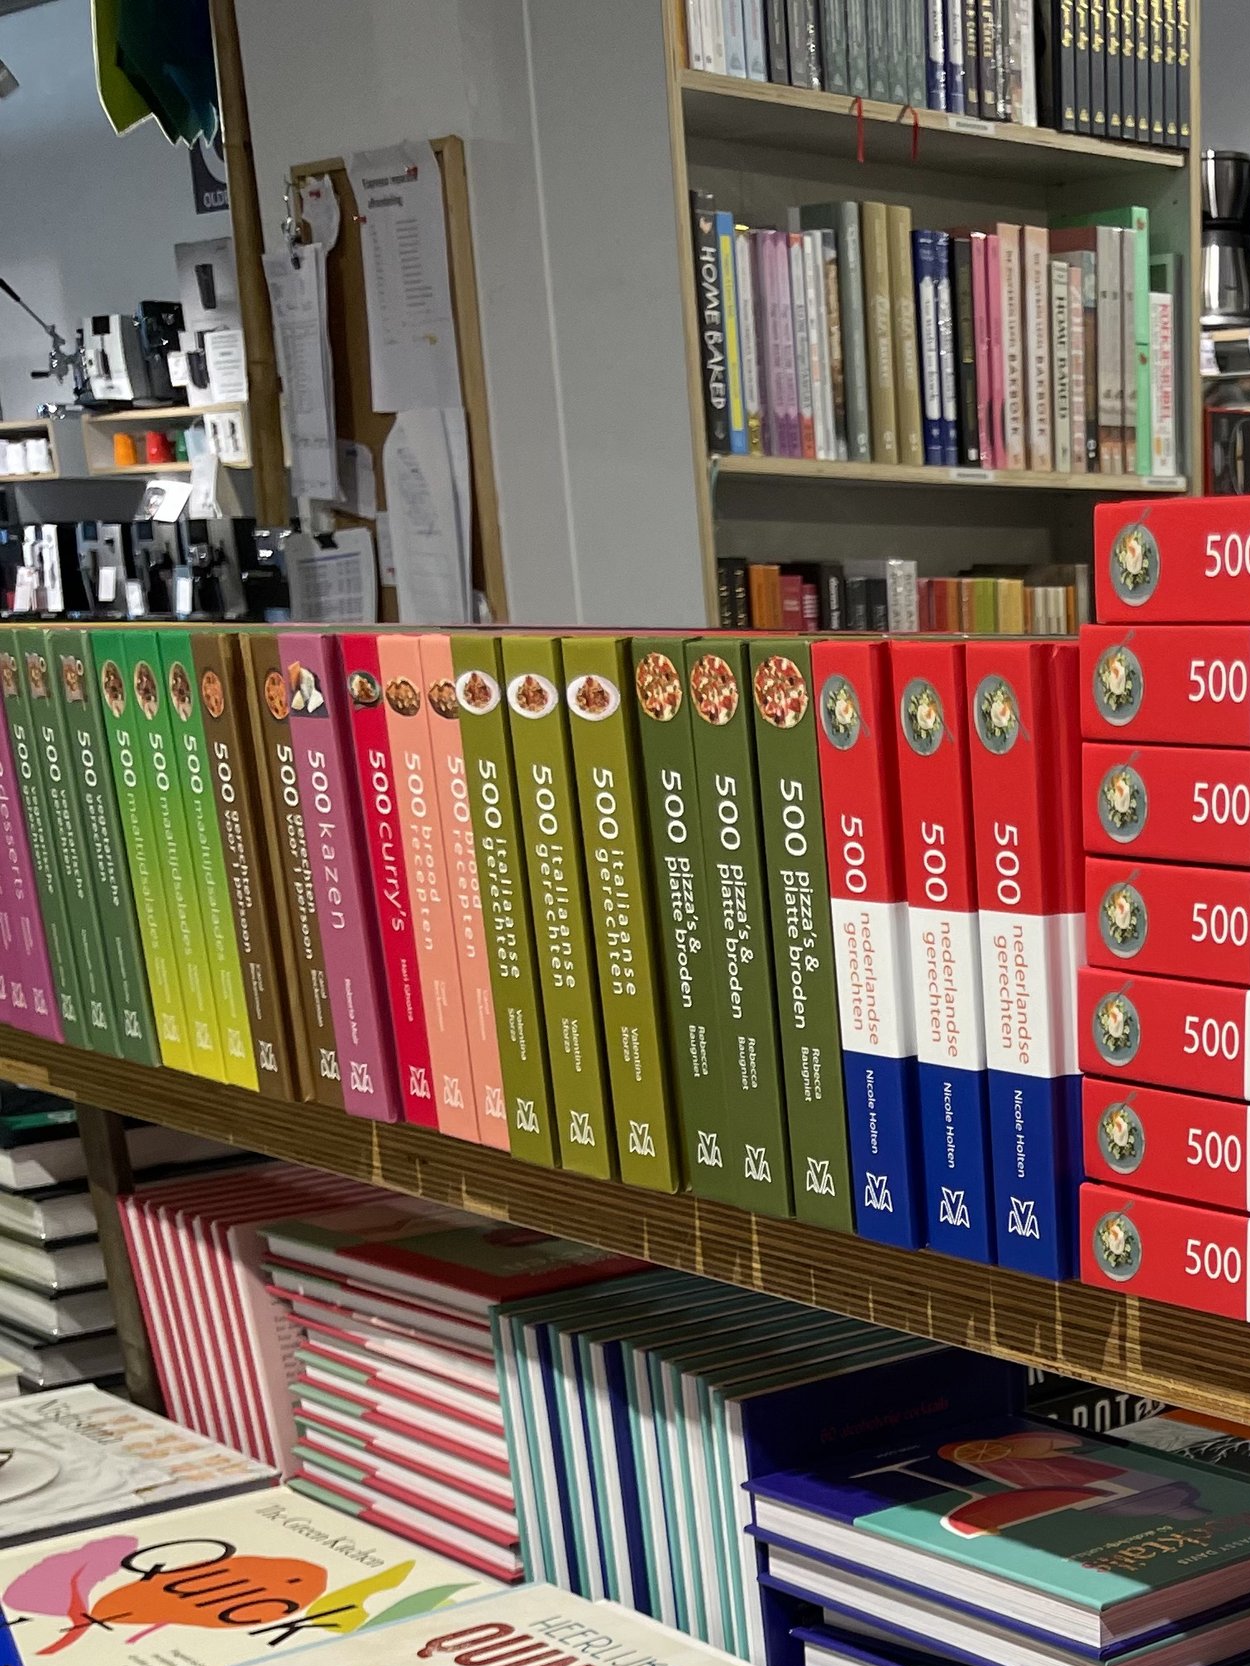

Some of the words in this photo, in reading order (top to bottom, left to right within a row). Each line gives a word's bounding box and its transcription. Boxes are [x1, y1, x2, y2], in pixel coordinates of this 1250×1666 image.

[699, 246, 722, 326] HOME
[704, 330, 726, 410] BAKED
[1188, 660, 1247, 702] 500
[307, 749, 332, 815] 500
[369, 749, 392, 816] 500
[592, 767, 619, 841] 500
[780, 777, 808, 858] 500
[1191, 782, 1250, 825] 500
[319, 821, 346, 930] kazen
[378, 821, 405, 932] curry's
[921, 821, 949, 903] 500
[993, 821, 1022, 906] 500
[595, 848, 623, 997] gerechten
[611, 849, 637, 998] italiaanse
[780, 869, 800, 941] platte
[795, 871, 814, 951] pizza's
[1191, 902, 1248, 947] 500
[788, 943, 807, 1031] broden
[803, 953, 818, 973] &
[922, 931, 943, 1044] gerechten
[940, 921, 959, 1059] nederlandse
[993, 935, 1013, 1050] gerechten
[1012, 925, 1030, 1065] nederlandse
[621, 1026, 631, 1063] Sforza
[630, 1027, 643, 1082] Valentina
[801, 1046, 813, 1102] Baugniet
[810, 1047, 823, 1100] Rebecca
[1183, 1016, 1240, 1061] 500
[1013, 1089, 1025, 1133] Nicole
[1016, 1135, 1026, 1179] Holten
[1186, 1128, 1241, 1173] 500
[1184, 1239, 1241, 1284] 500
[256, 1503, 282, 1522] The
[283, 1517, 326, 1543] Green
[321, 1536, 387, 1569] Kitchen
